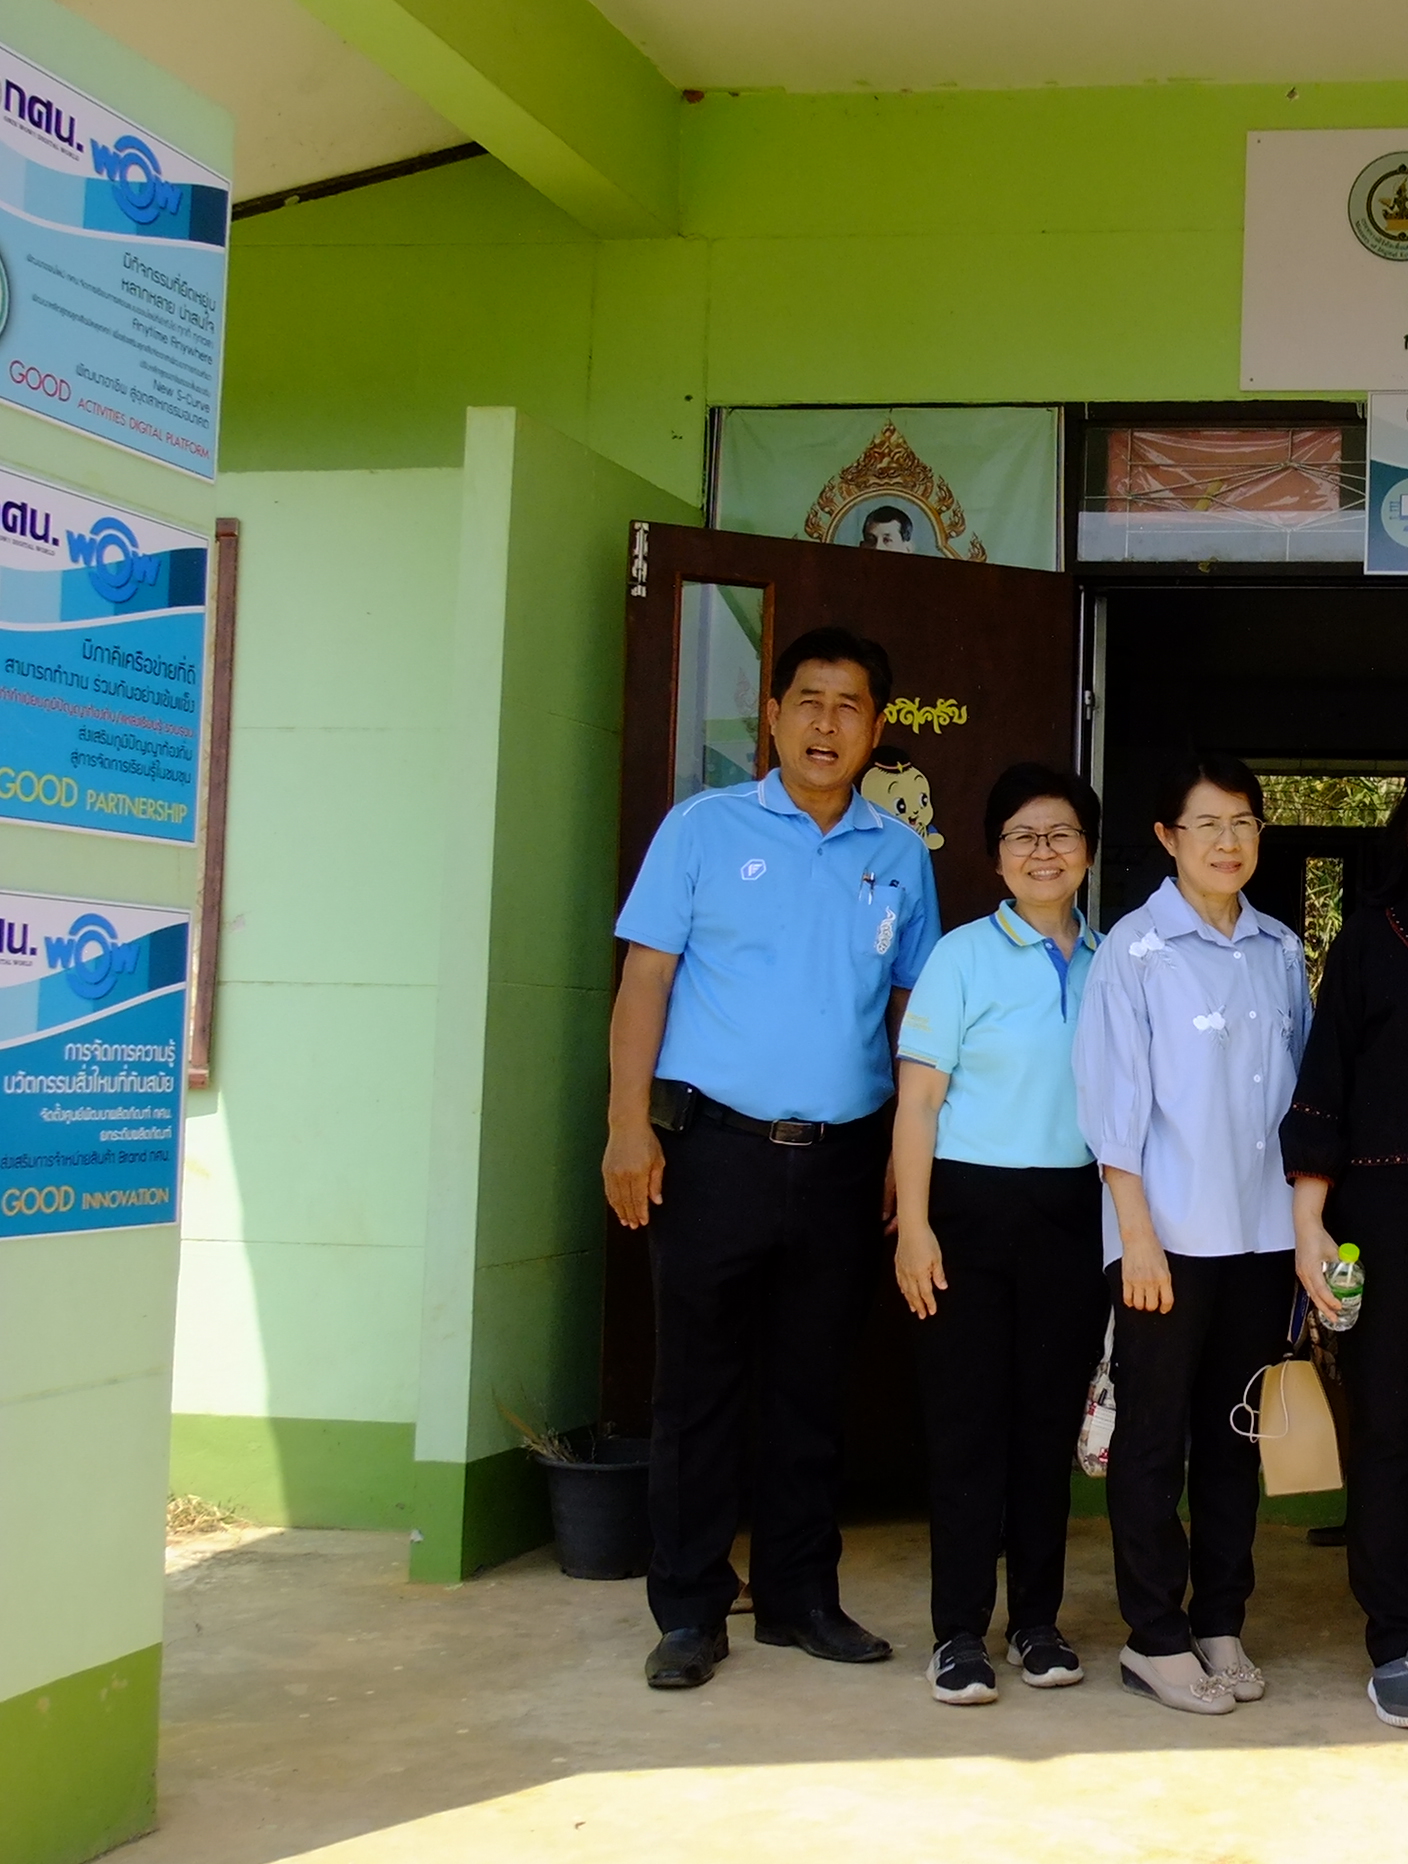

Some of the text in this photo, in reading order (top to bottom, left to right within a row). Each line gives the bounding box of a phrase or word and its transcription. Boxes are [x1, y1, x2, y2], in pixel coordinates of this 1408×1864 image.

[5, 79, 84, 153] กศน.
[90, 135, 183, 225] WOW
[121, 278, 175, 314] หลากหลาย
[132, 317, 168, 345] Anytime
[170, 335, 213, 365] Anywhere
[9, 360, 209, 459] GOOD ACTIVITIES DIGITAL PLATFORM
[153, 379, 174, 397] New
[66, 517, 161, 603] WOW
[5, 658, 89, 690] สามารถทำงาน
[82, 638, 196, 685] มีภาคีเครือข่ายที่ดี
[0, 766, 187, 824] GOOD PARTNERSHIP
[0, 918, 37, 955] น.
[44, 913, 139, 1000] WOW
[65, 1039, 175, 1067] การจัดการความรู้
[2, 1185, 169, 1216] GOOD INNOVATION
